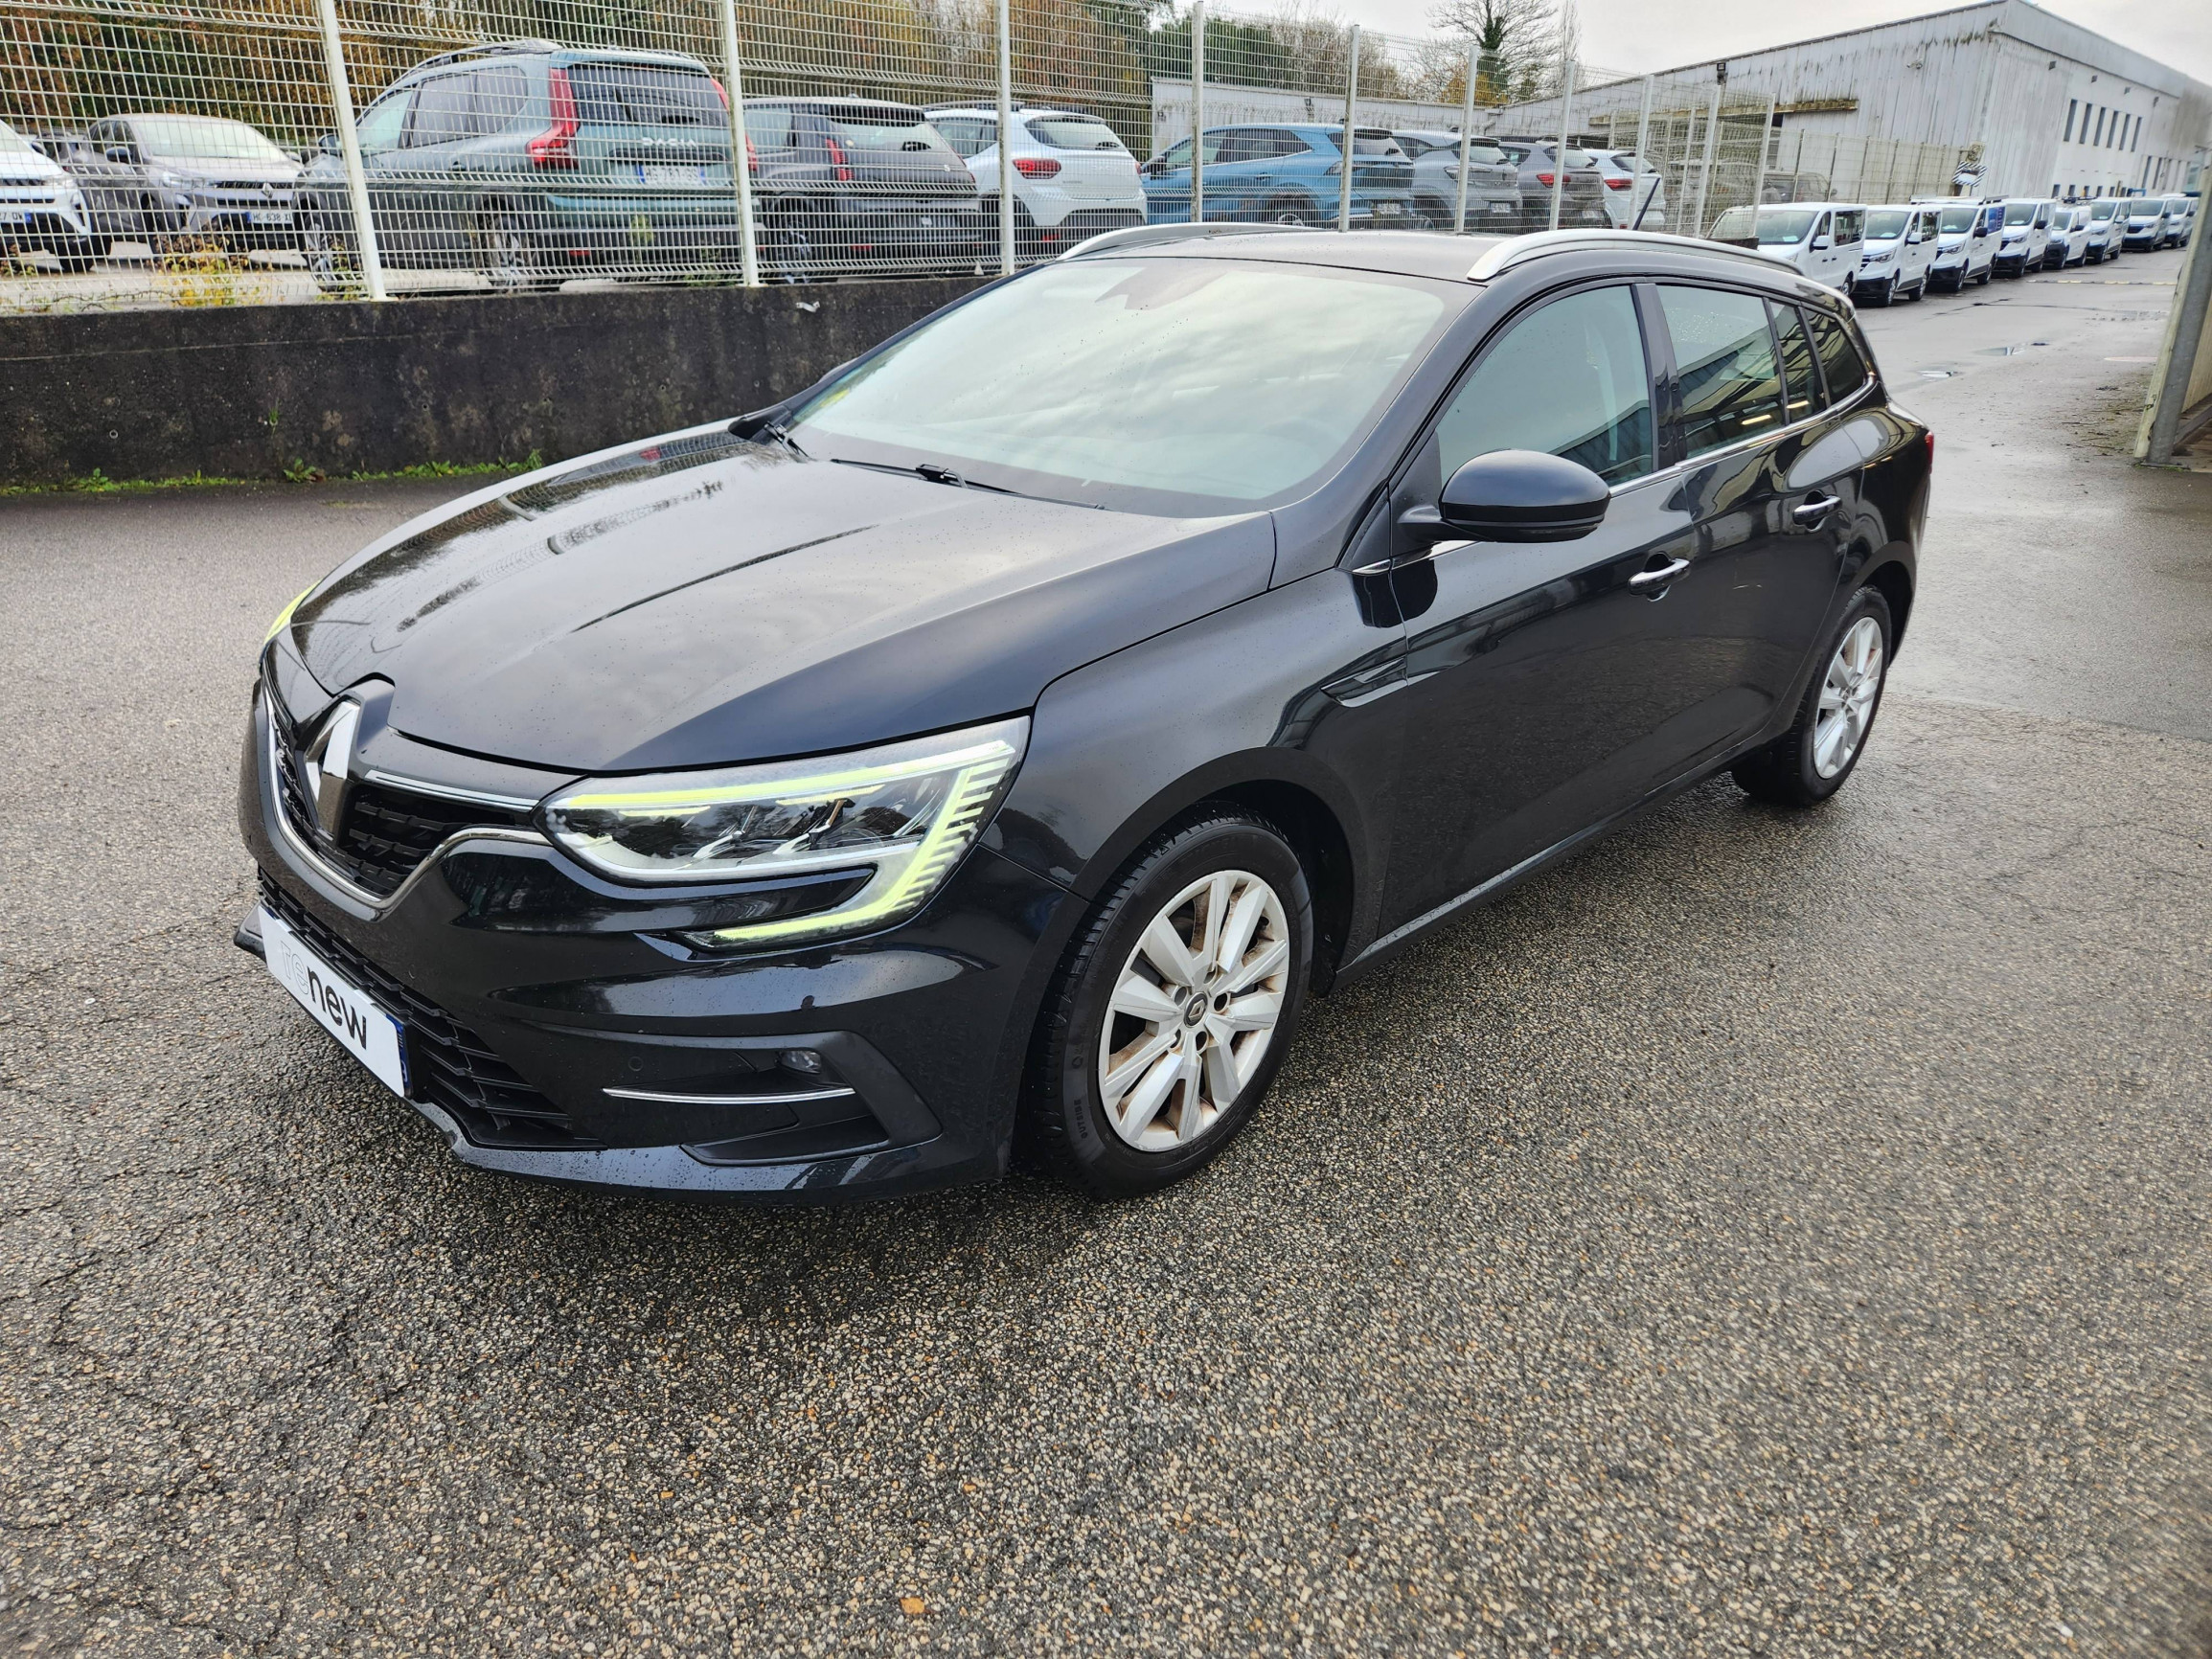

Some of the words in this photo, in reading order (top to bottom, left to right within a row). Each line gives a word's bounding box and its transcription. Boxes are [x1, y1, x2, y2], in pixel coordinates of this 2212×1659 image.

[642, 137, 697, 147] DACIA
[281, 941, 367, 1050] renew
[1074, 1099, 1088, 1140] OUTSIDE
